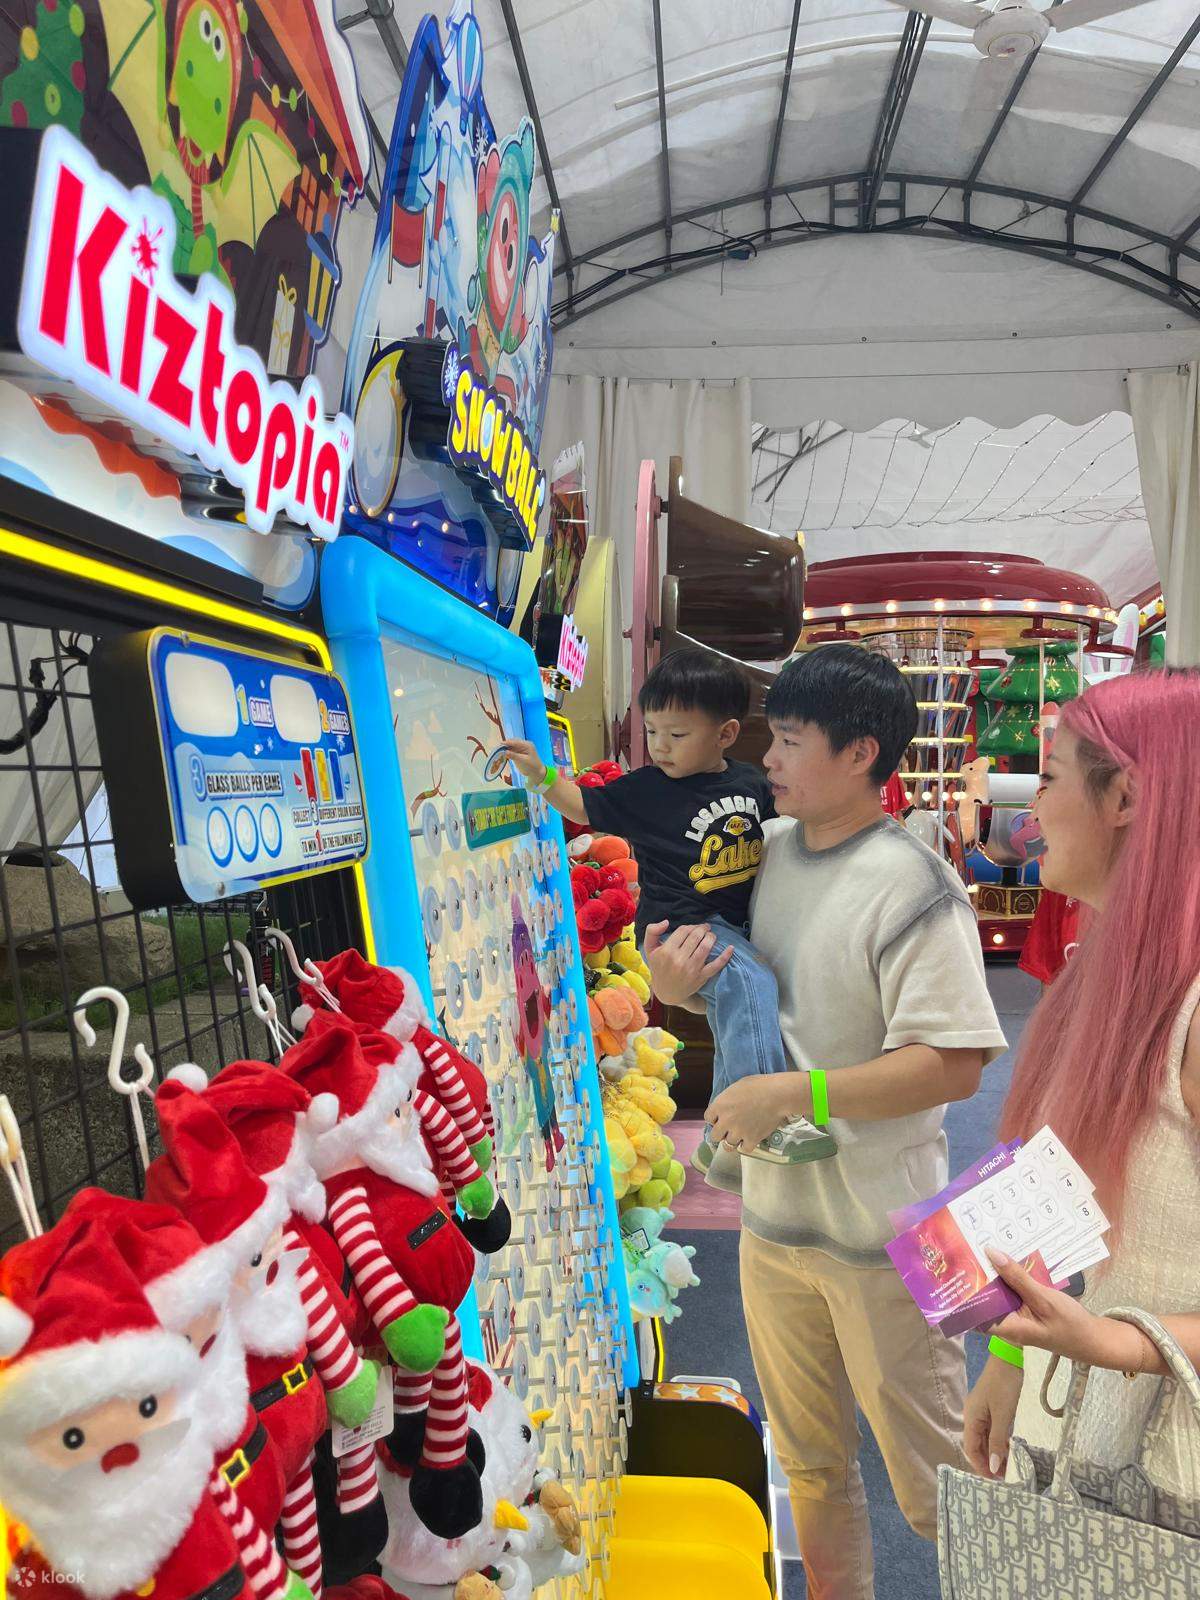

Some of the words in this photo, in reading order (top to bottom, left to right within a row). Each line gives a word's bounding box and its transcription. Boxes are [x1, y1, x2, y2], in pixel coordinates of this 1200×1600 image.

[38, 163, 341, 526] Kiztopia
[236, 685, 249, 724] 1
[250, 699, 273, 724] GAME
[319, 699, 330, 732] 2
[330, 712, 349, 733] GAMES
[190, 755, 206, 801] 3
[206, 775, 231, 793] GLASS
[231, 775, 251, 792] BALLS
[251, 775, 263, 791] PER
[263, 774, 281, 791] GAME
[977, 1151, 1007, 1178] HITACHI
[989, 1200, 997, 1210] 2
[1008, 1187, 1016, 1198] 3
[1029, 1175, 1036, 1185] 4
[1066, 1178, 1072, 1188] 4
[1005, 1230, 1013, 1241] 6
[1025, 1216, 1032, 1228] 7
[1045, 1203, 1053, 1214] 8
[1082, 1206, 1090, 1217] 8
